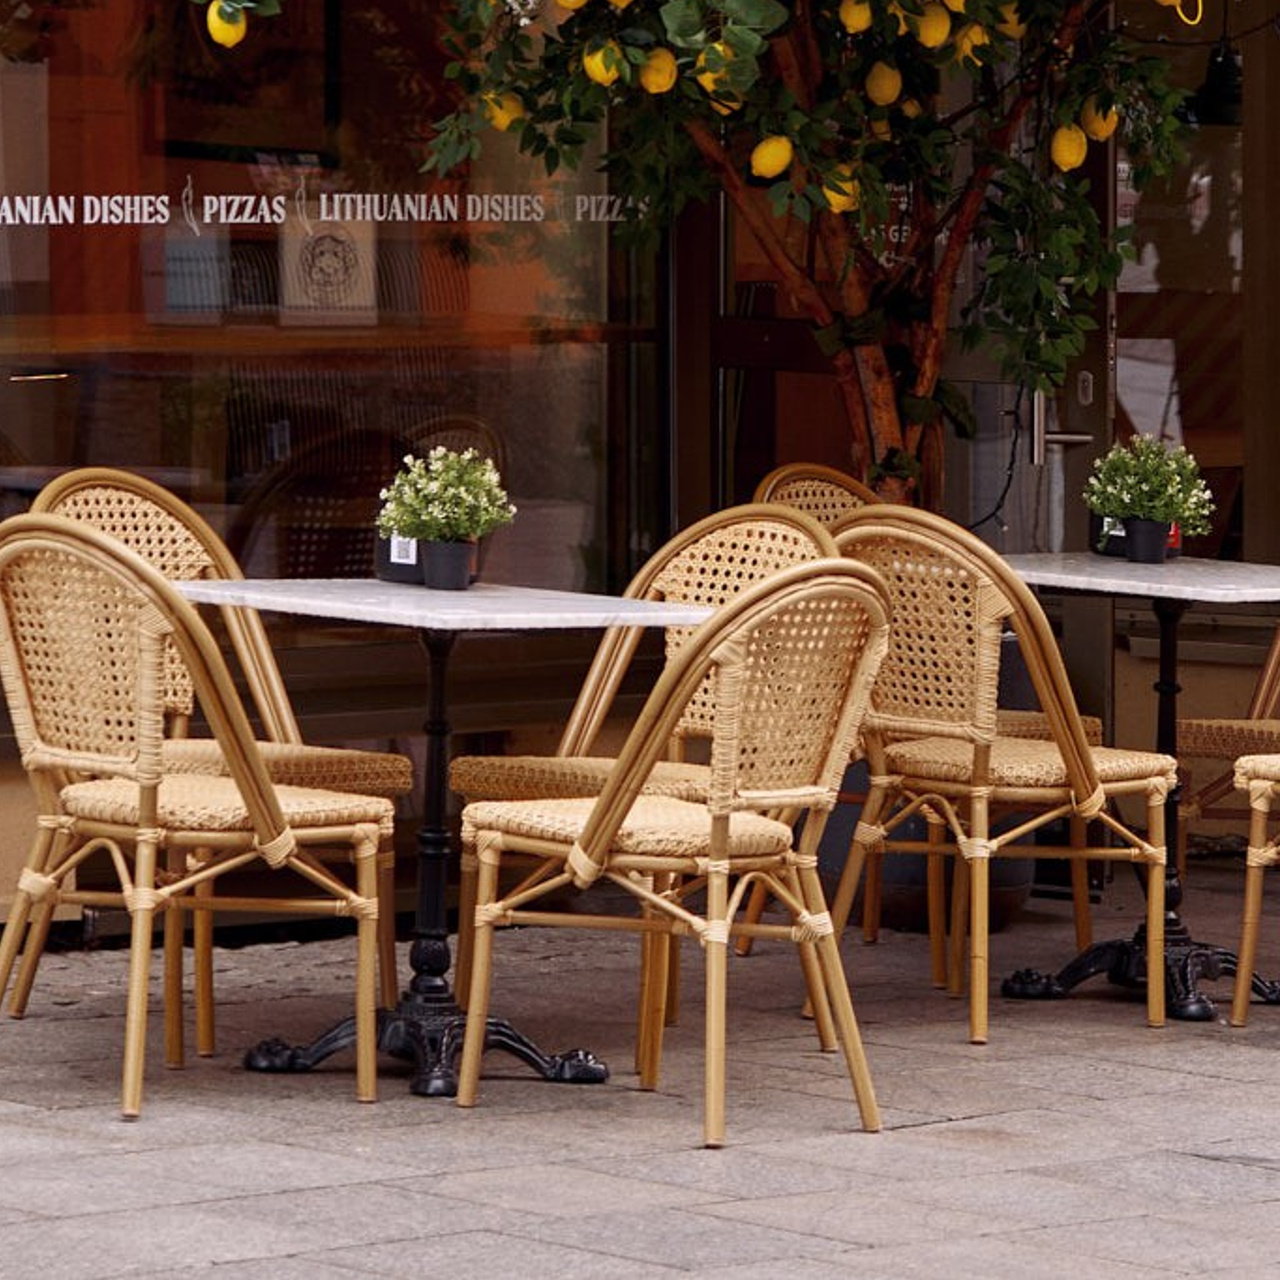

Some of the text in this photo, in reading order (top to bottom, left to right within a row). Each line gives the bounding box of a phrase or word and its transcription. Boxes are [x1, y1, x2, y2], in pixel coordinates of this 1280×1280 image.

[83, 195, 170, 224] DISHES
[203, 195, 287, 224] PIZZAS
[319, 193, 459, 221] LITHUANIAN
[466, 193, 545, 221] DISHES
